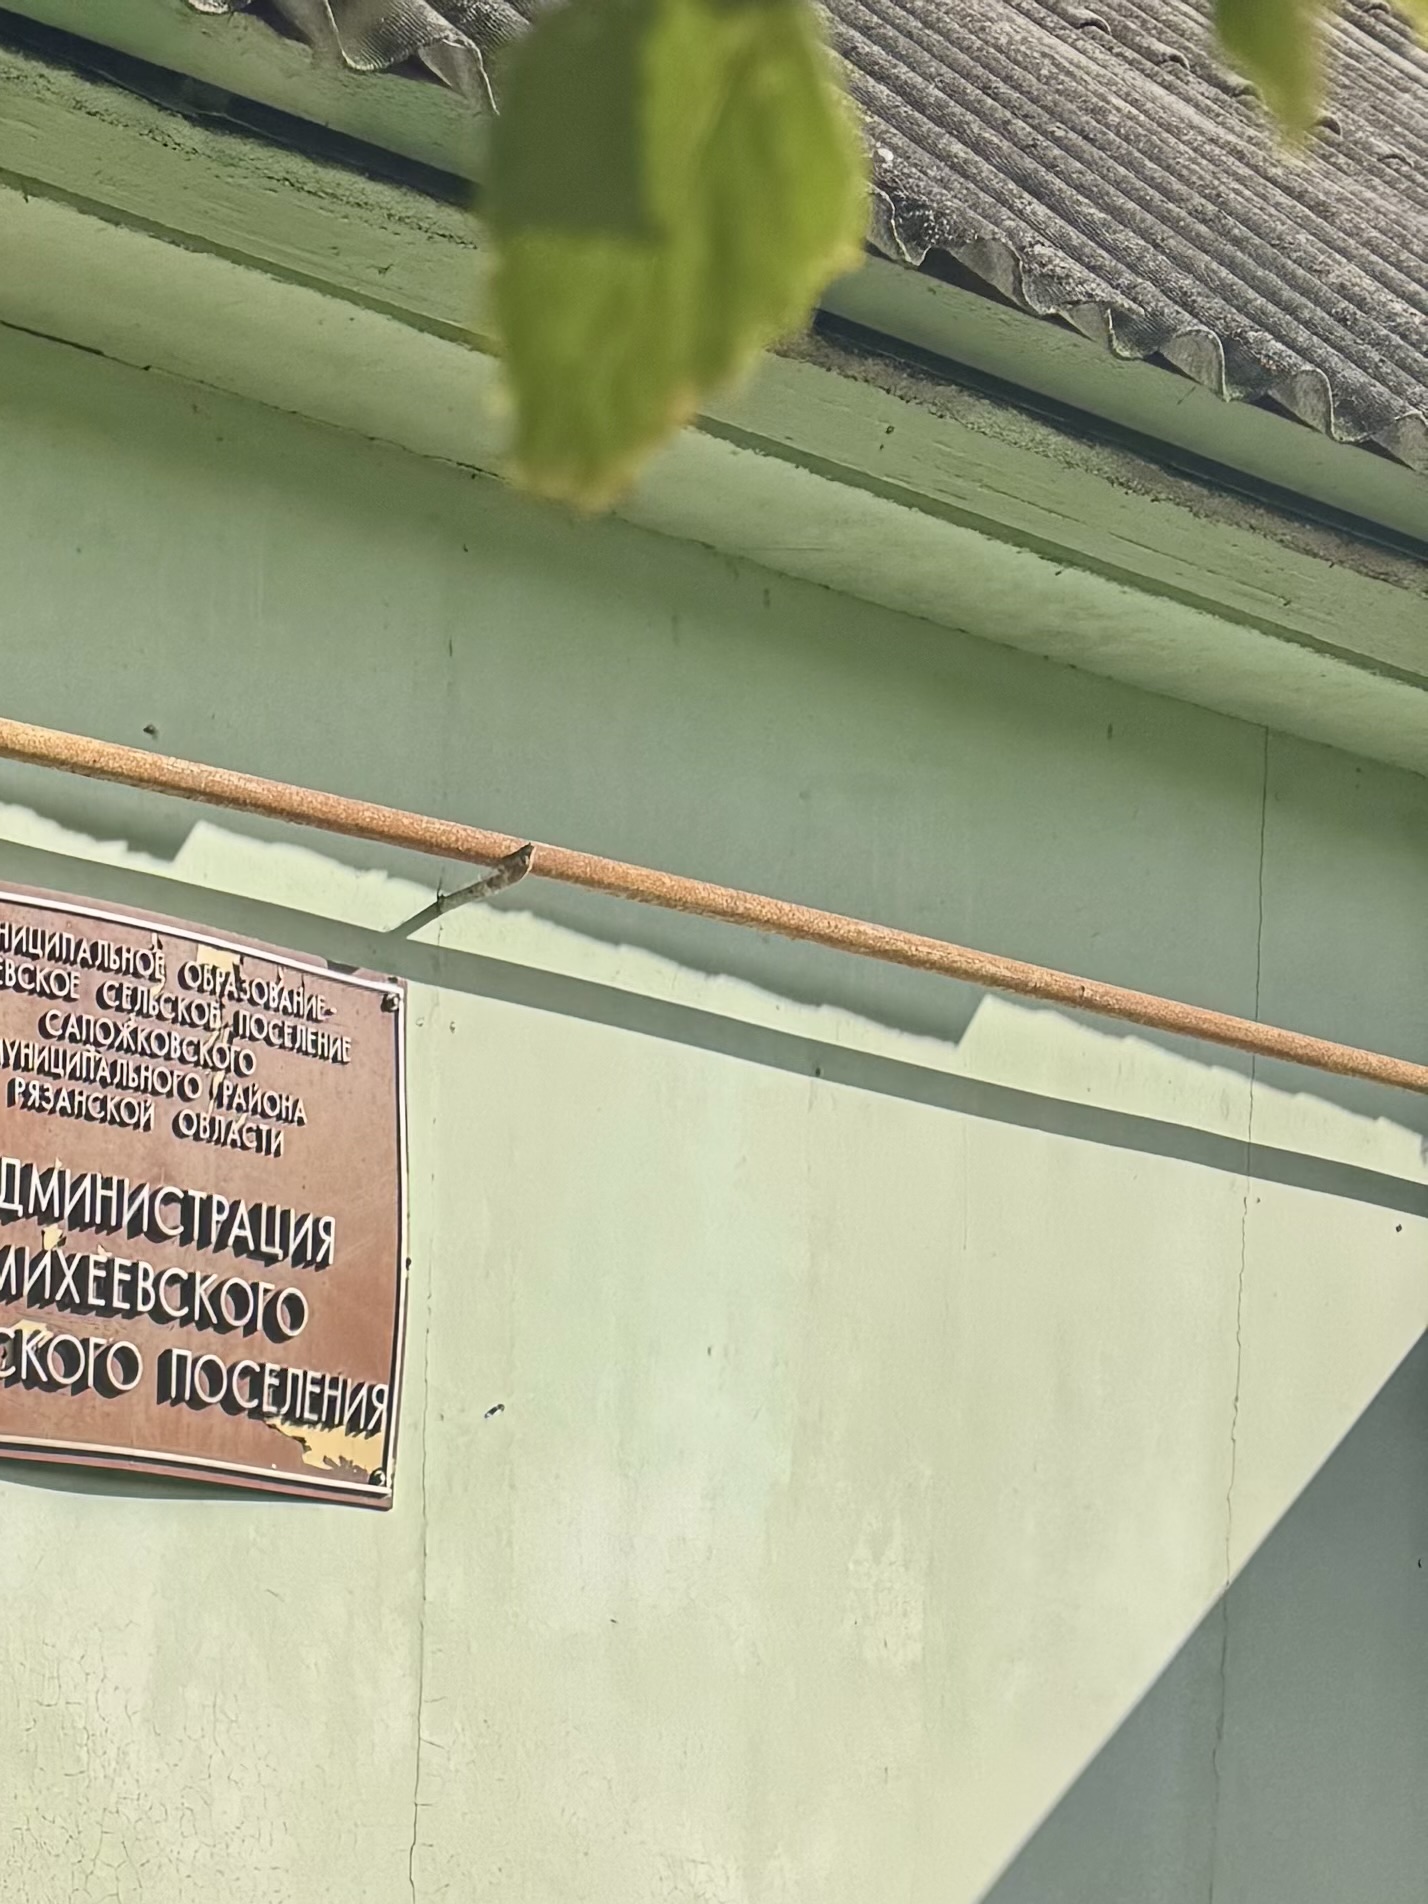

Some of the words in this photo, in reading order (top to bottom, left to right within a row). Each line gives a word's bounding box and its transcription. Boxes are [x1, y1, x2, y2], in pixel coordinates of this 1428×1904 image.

[44, 1008, 257, 1076] САПОЖКОВСКОГО
[102, 979, 222, 1030] СЕЛЬСКОЕ
[237, 1009, 352, 1063] ПОСЕЛЕНИЕ
[13, 1076, 155, 1132] РЯЗАНСКОЙ
[222, 1079, 308, 1125] РАЙОНА
[170, 1347, 389, 1431] ПОСЕЛЕНИЯ
